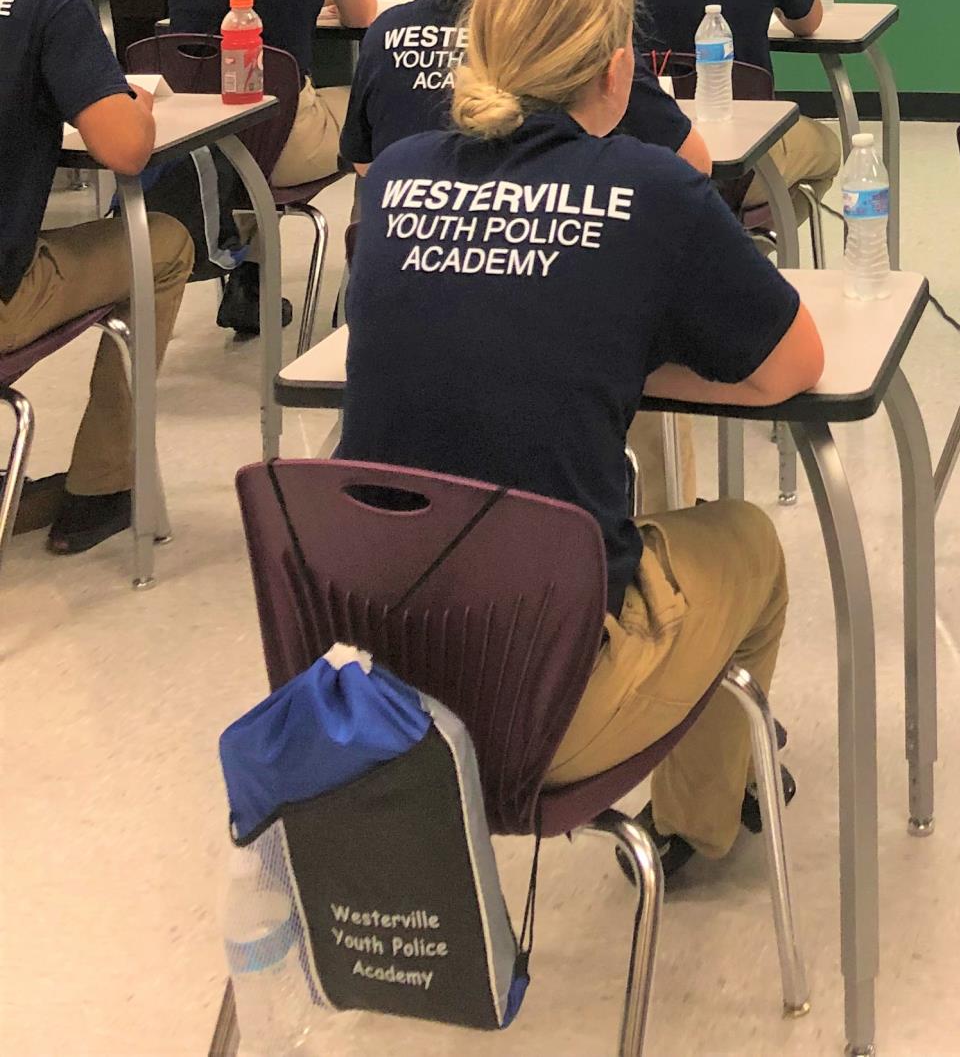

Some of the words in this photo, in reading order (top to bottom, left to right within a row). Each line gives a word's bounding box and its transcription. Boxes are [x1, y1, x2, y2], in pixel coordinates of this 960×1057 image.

[384, 25, 470, 50] WESTE
[392, 50, 465, 68] YOUTH
[412, 72, 456, 89] ACA
[381, 179, 634, 221] WESTERVILLE
[385, 213, 478, 242] YOUTH
[483, 216, 604, 249] POLICE
[401, 245, 560, 277] ACADEMY
[330, 903, 440, 929] Westerville
[331, 927, 384, 955] Youth
[392, 936, 449, 958] Police
[352, 959, 433, 990] Academy
